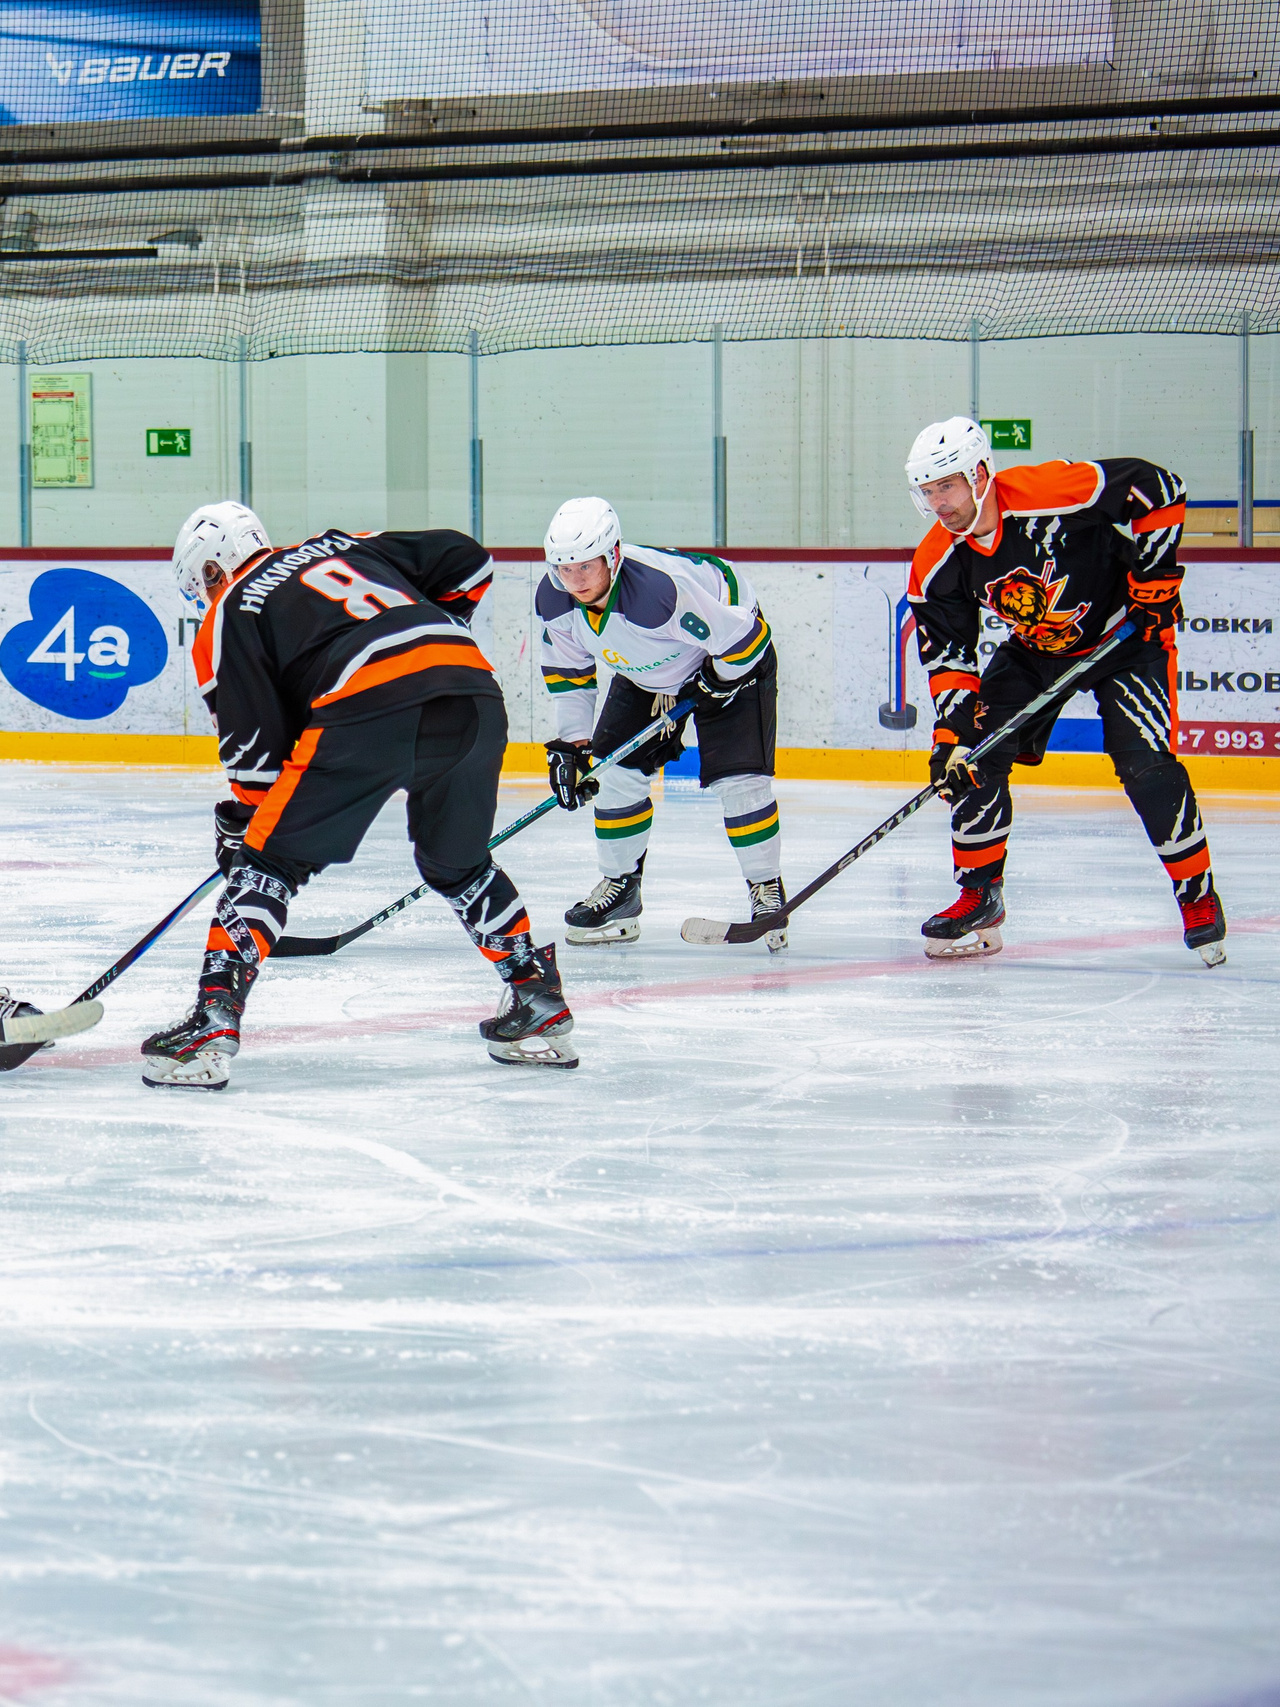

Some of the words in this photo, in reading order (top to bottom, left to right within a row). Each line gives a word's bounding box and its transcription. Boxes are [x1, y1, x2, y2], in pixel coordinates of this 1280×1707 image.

[77, 52, 231, 85] BAUER
[300, 557, 418, 621] 8
[680, 611, 711, 641] 8
[26, 605, 130, 681] 4a
[1177, 671, 1280, 693] ЬКОВ
[1214, 730, 1265, 750] 993
